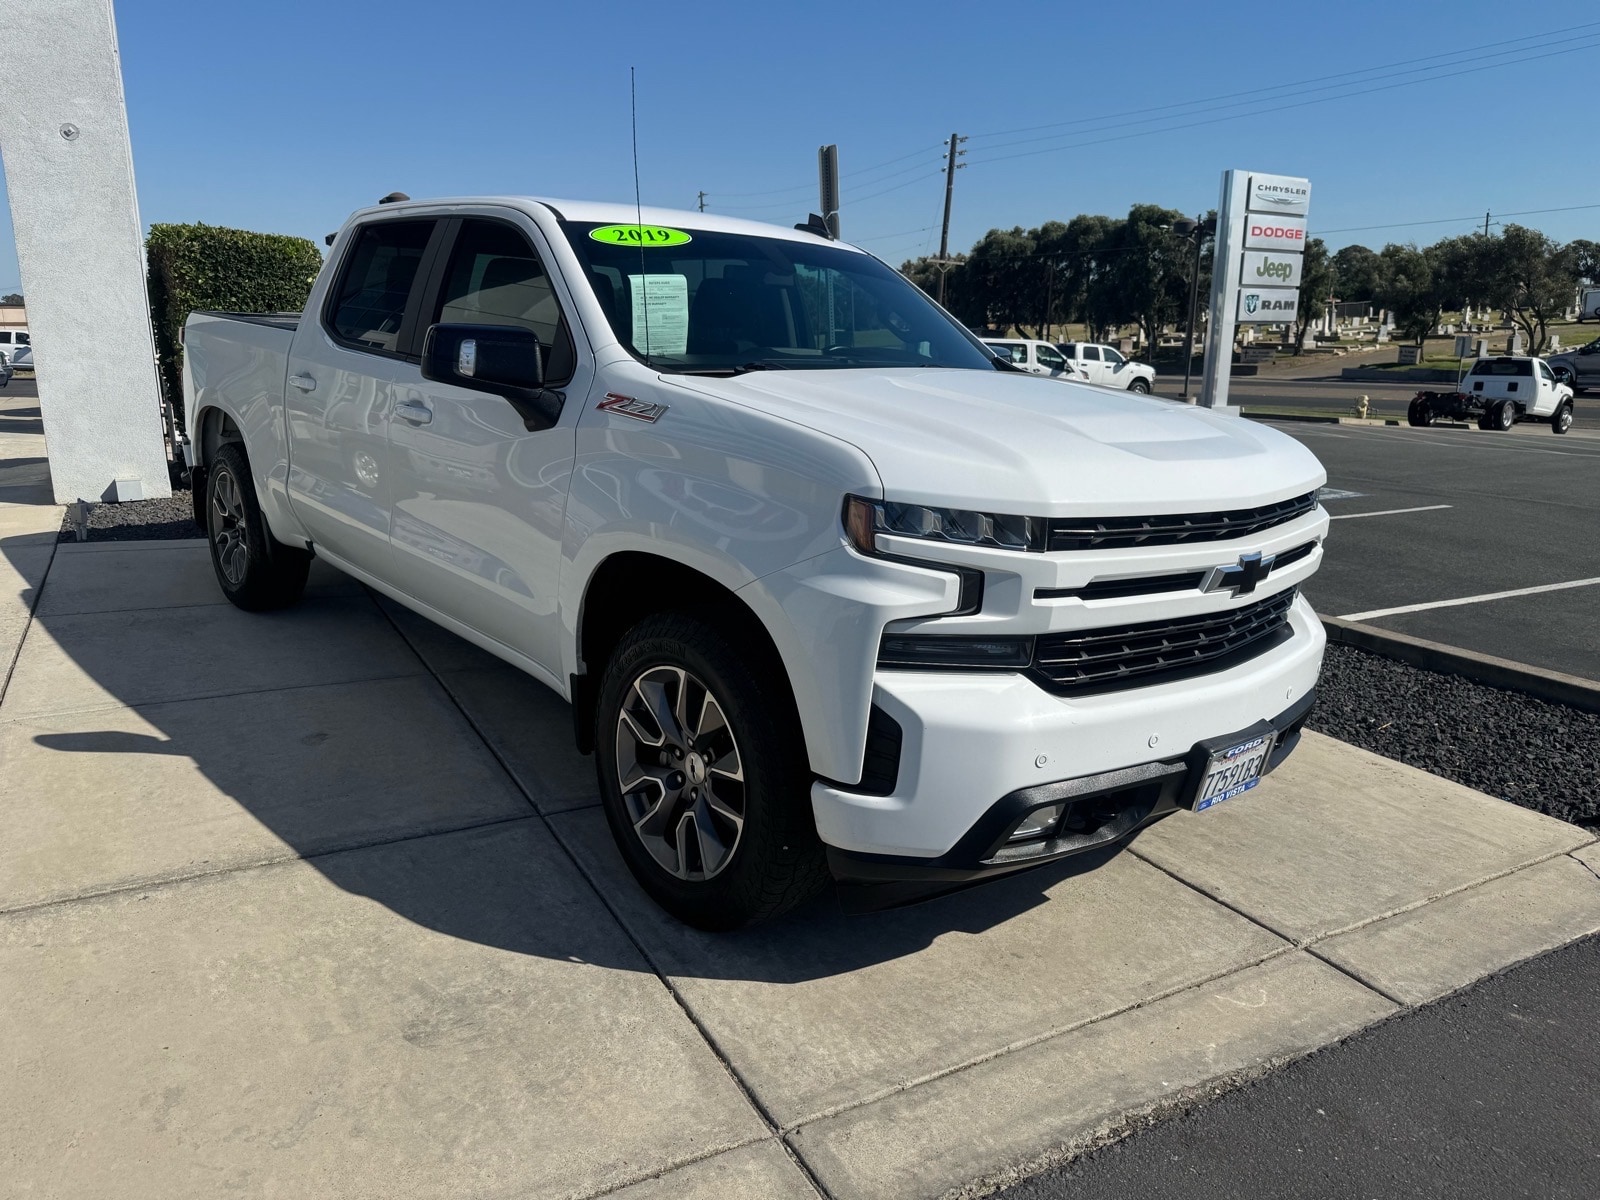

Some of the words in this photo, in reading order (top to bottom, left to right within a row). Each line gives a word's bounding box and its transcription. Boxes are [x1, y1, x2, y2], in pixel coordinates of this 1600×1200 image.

[1257, 184, 1307, 196] CHRYSLER
[612, 229, 670, 242] 2019
[1251, 226, 1303, 240] DODGE
[1256, 256, 1293, 282] Jeep
[1261, 300, 1295, 311] RAM
[595, 391, 671, 424] Z71
[1227, 738, 1262, 758] FORD
[1210, 793, 1225, 805] RIO
[1225, 784, 1246, 799] VISTA
